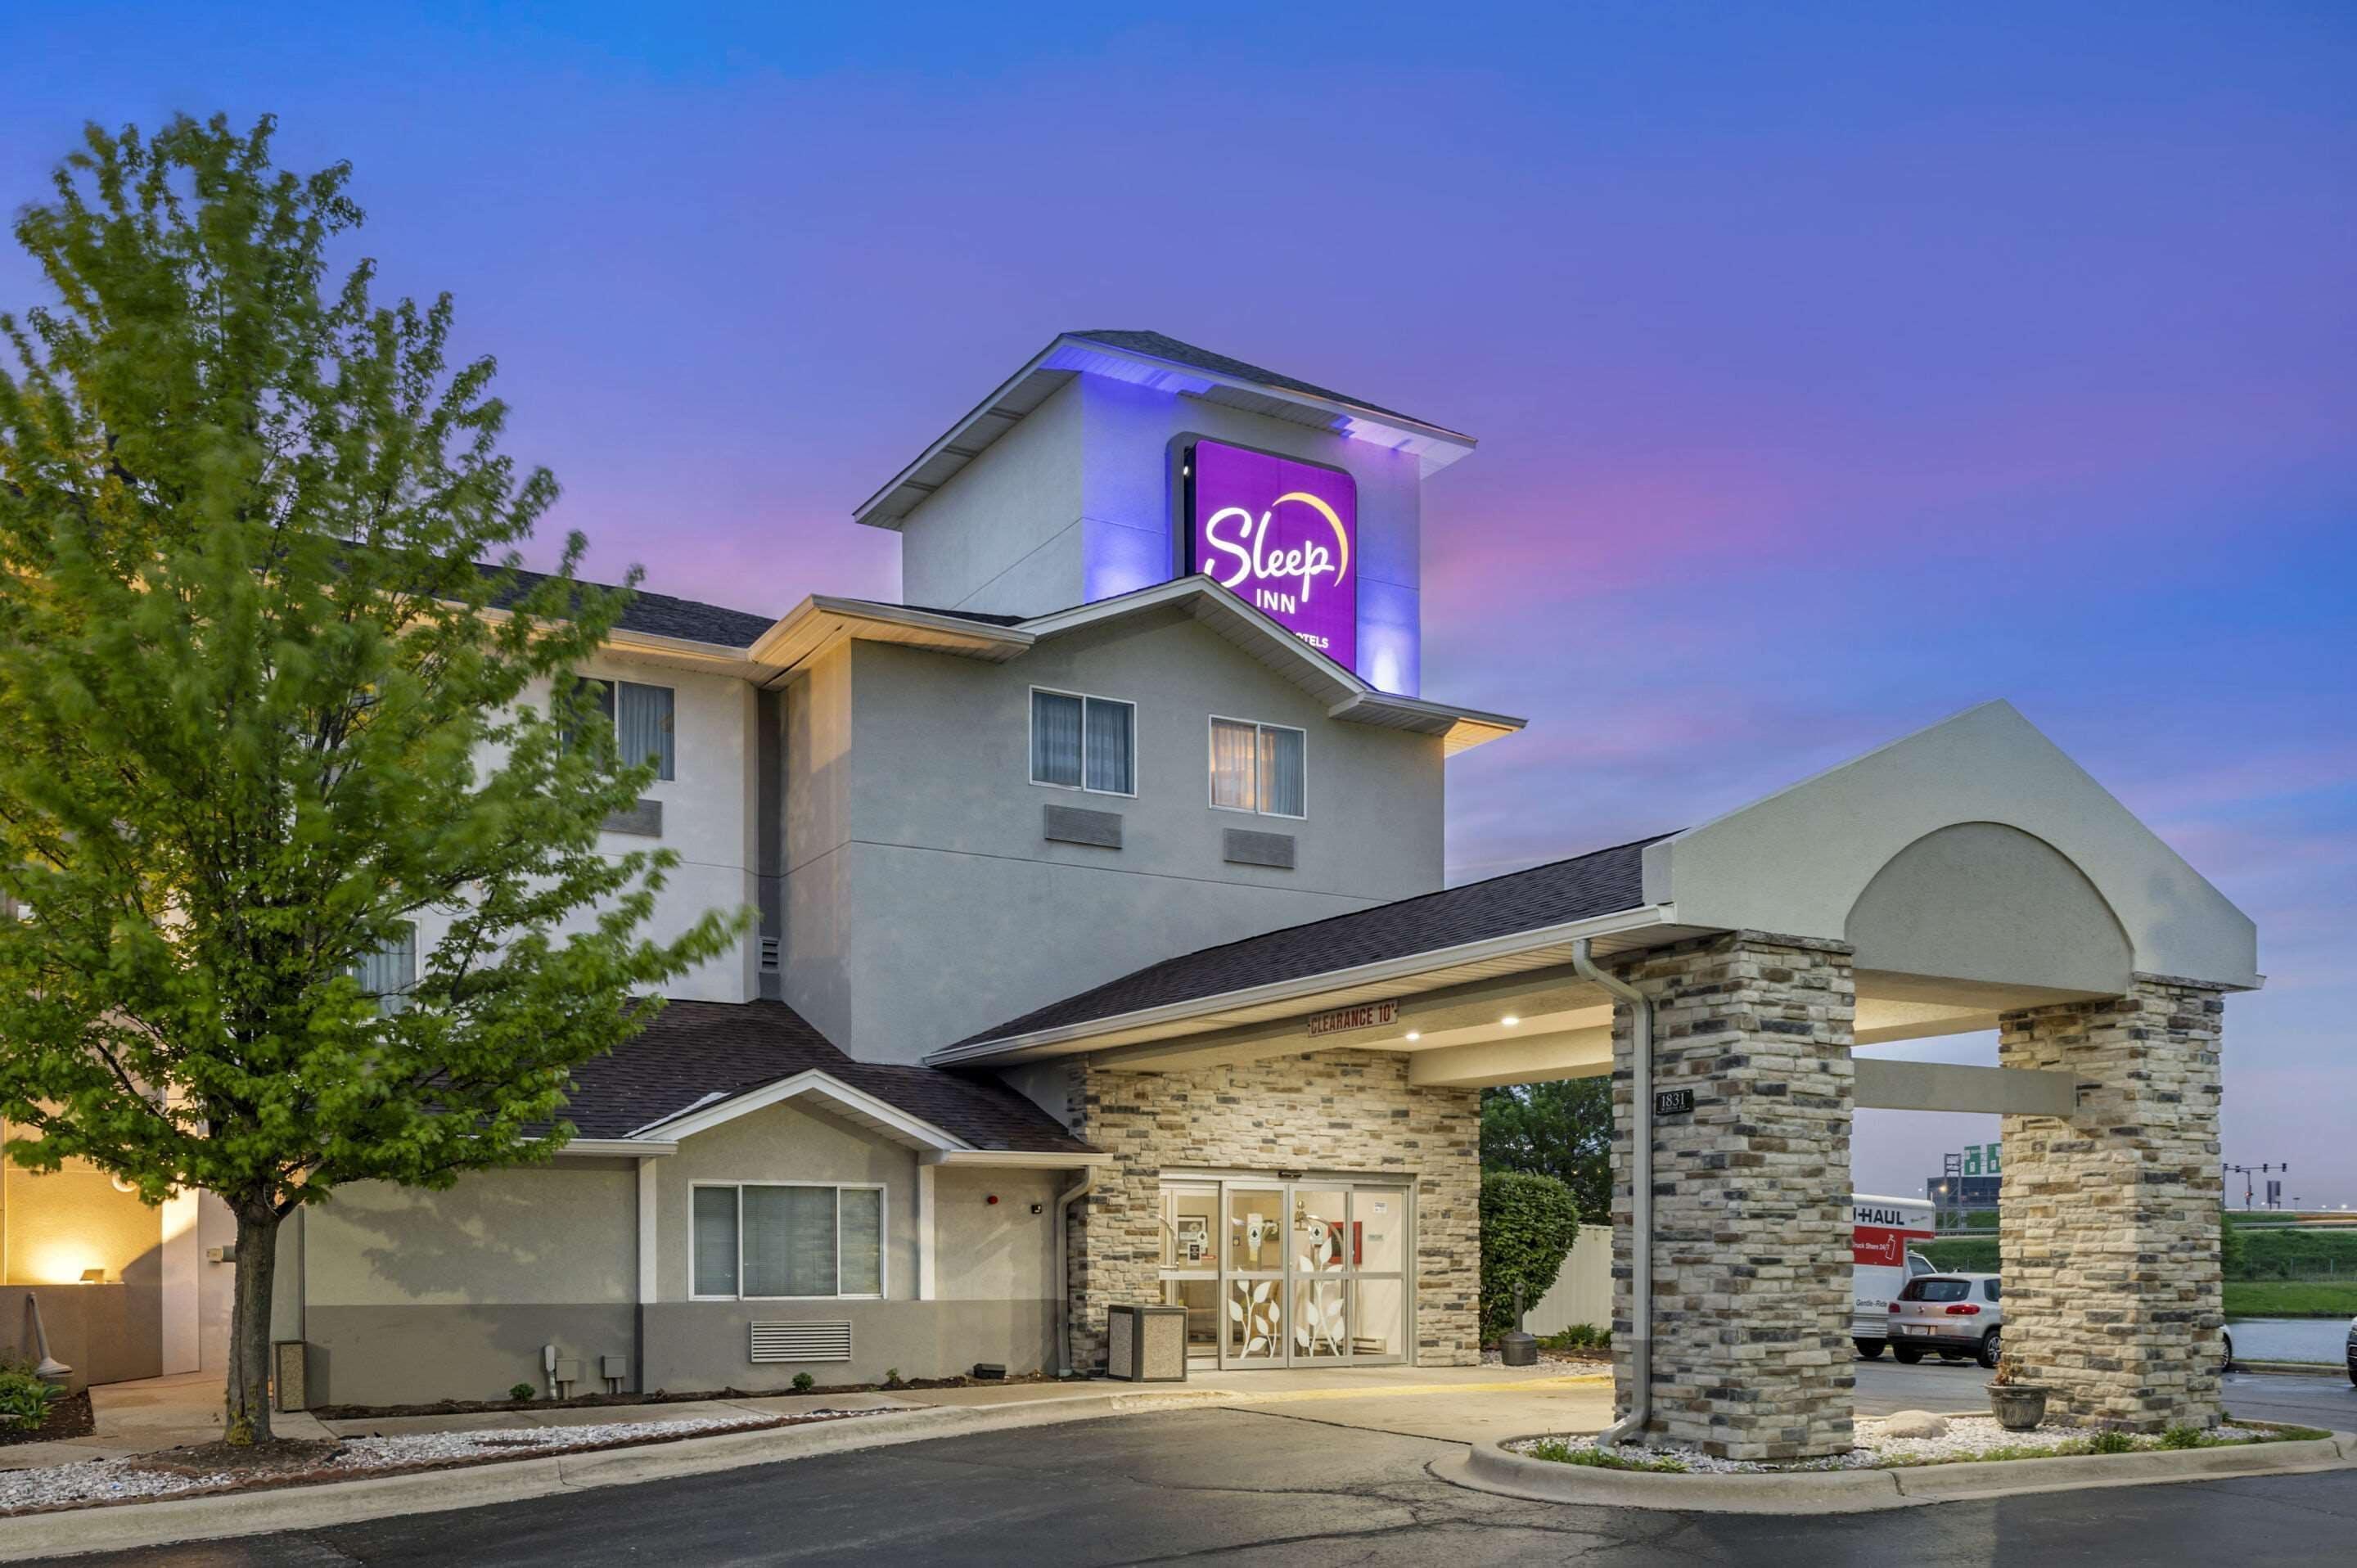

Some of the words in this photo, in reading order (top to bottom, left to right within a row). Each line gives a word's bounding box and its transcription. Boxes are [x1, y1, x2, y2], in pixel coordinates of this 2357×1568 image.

[1204, 507, 1335, 602] Sleep
[1256, 588, 1296, 615] INN
[1296, 632, 1329, 648] TELS
[1311, 1007, 1372, 1034] CLEARANCE
[1662, 1093, 1684, 1107] 1831
